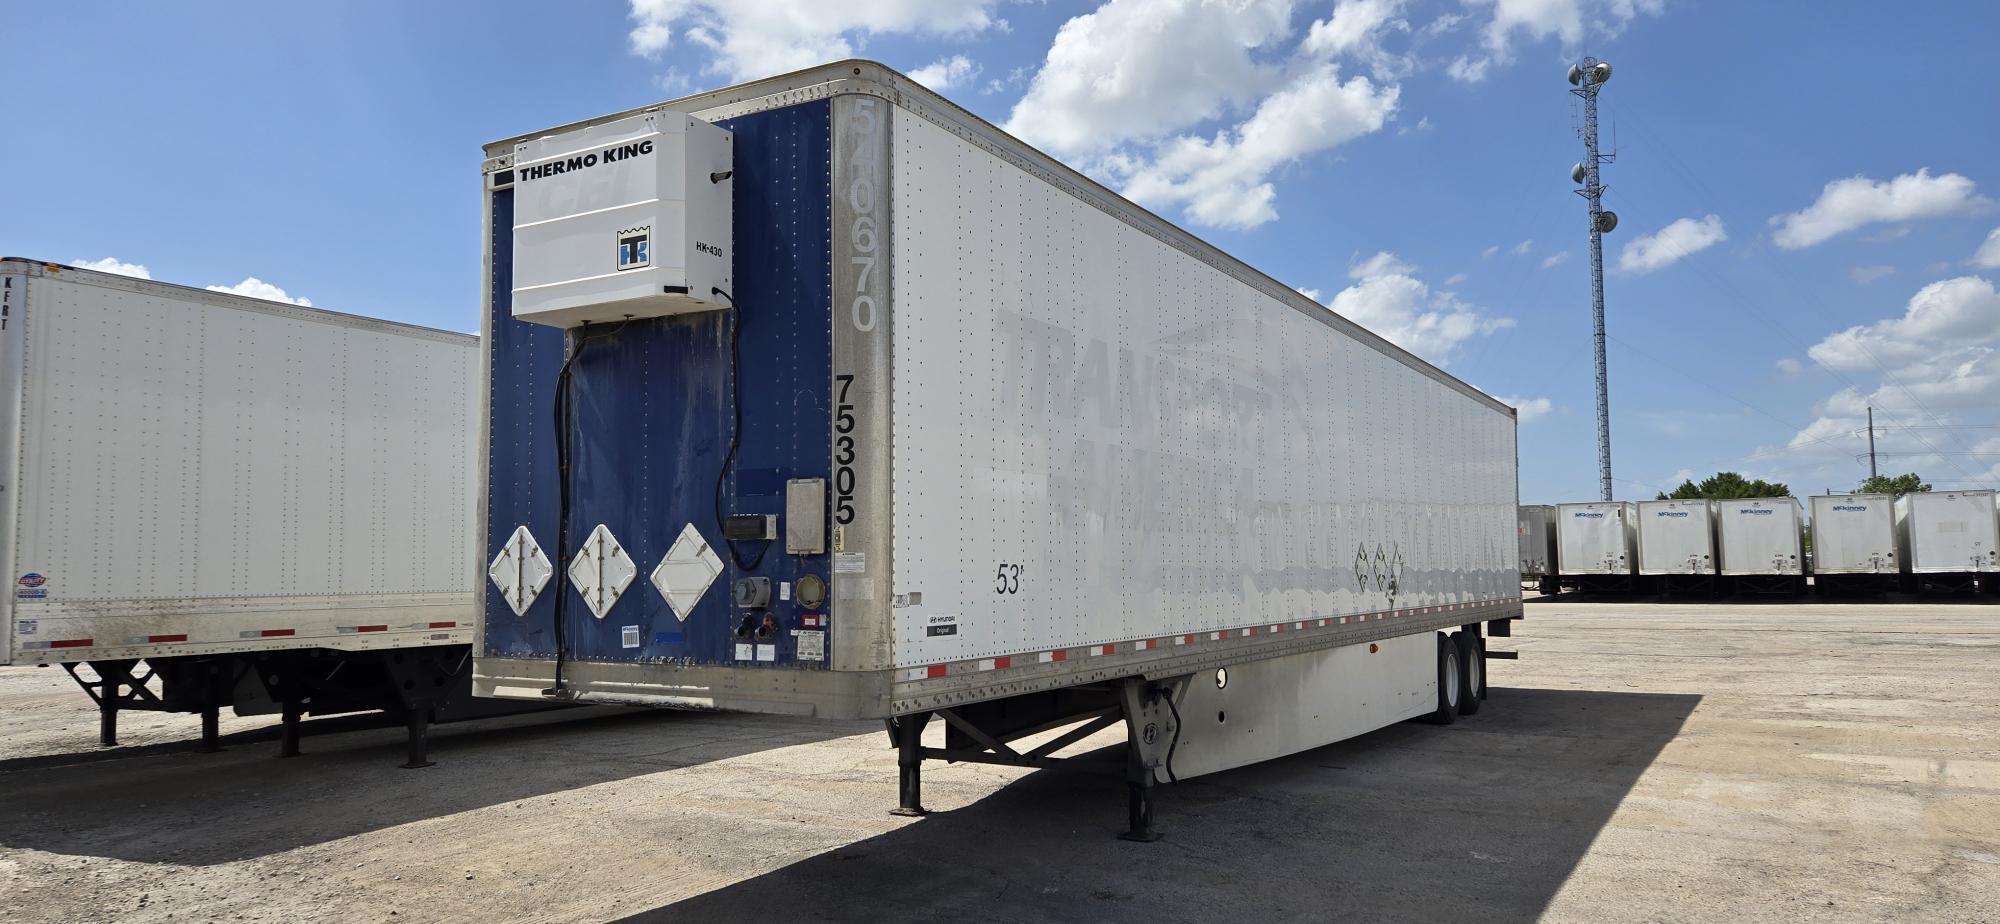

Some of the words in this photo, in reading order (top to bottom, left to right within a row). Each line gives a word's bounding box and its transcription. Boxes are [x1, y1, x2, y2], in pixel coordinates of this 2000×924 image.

[520, 153, 598, 182] THERMO
[603, 140, 654, 164] KING
[696, 241, 723, 258] HK-430
[835, 374, 856, 525] 75305
